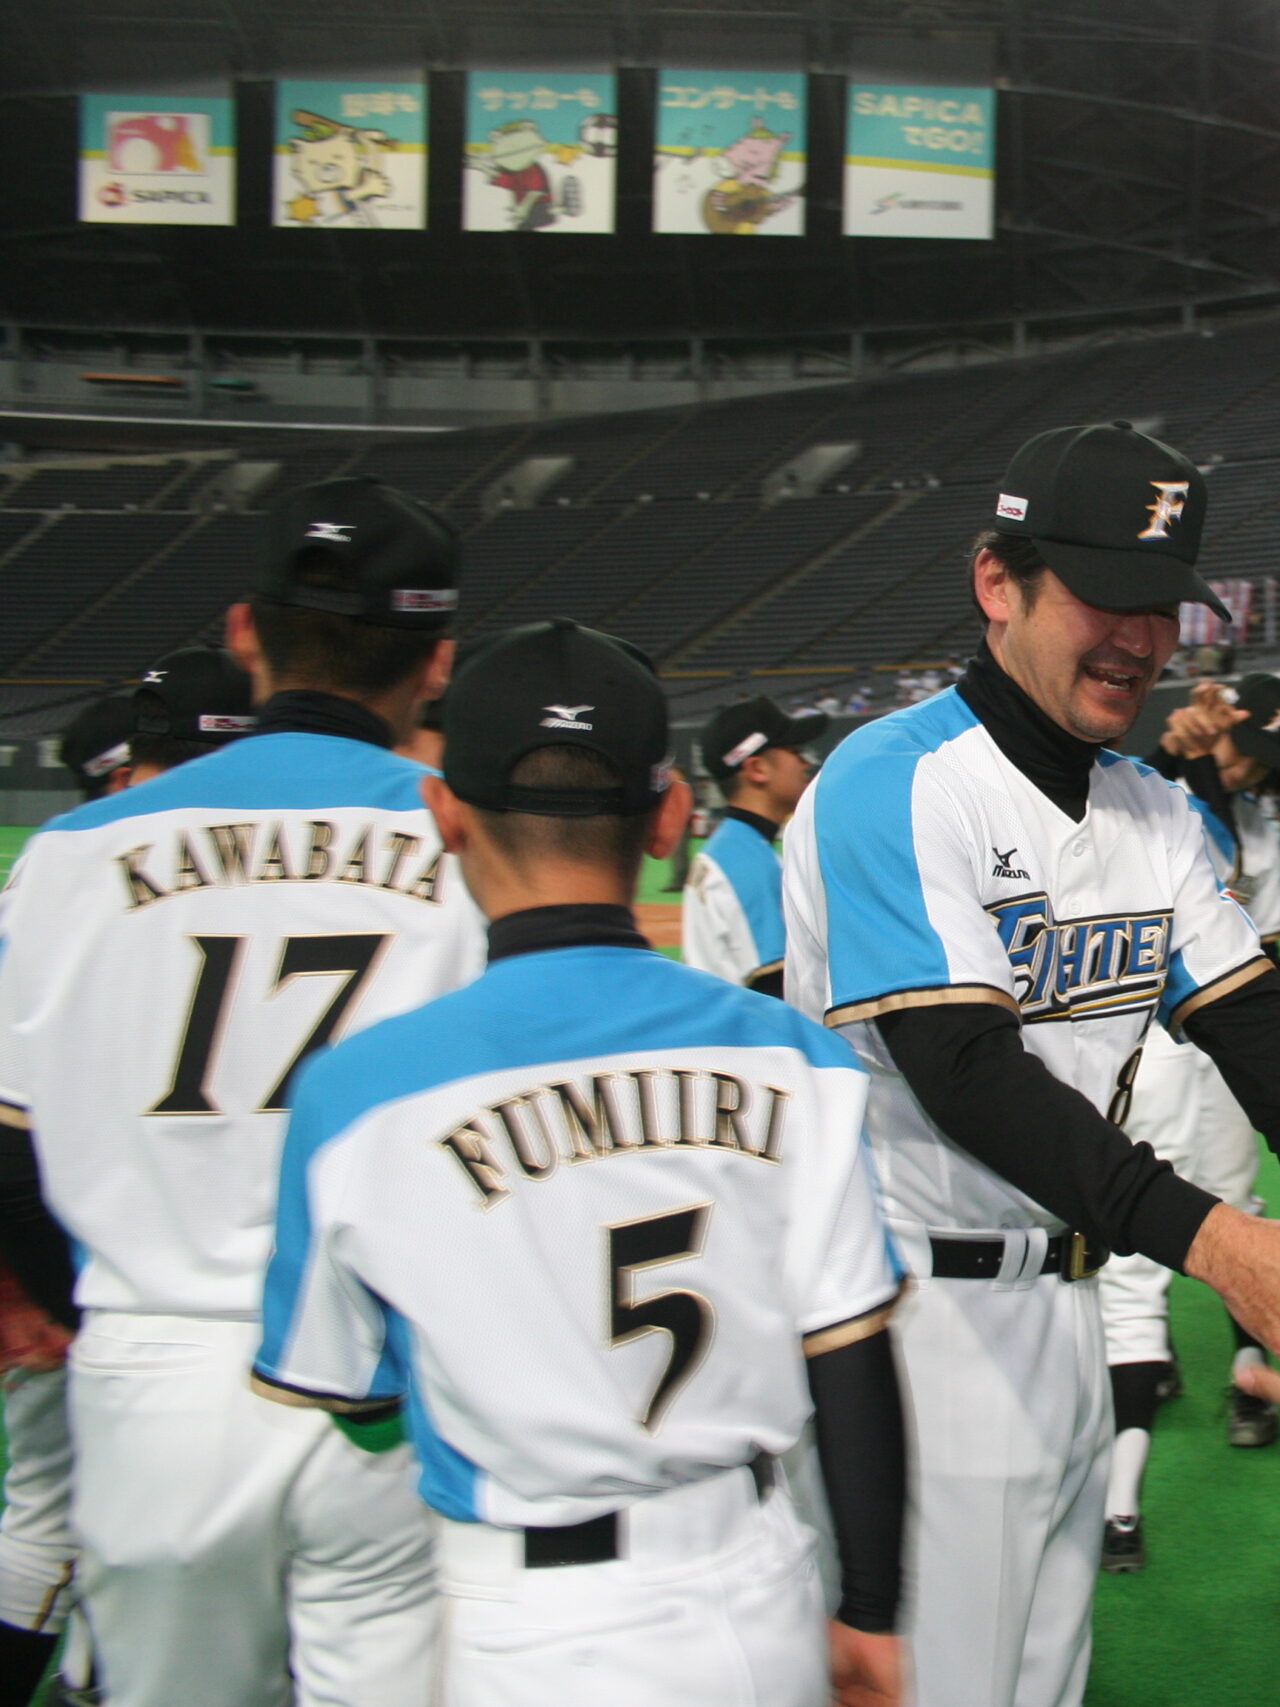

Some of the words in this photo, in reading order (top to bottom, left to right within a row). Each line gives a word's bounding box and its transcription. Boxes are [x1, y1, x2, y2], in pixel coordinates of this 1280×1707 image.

[853, 92, 985, 126] SAPICA
[113, 819, 449, 913] KAWABATA
[137, 931, 397, 1117] 17
[434, 1065, 794, 1213] FUMIIRI
[599, 1200, 717, 1437] 5
